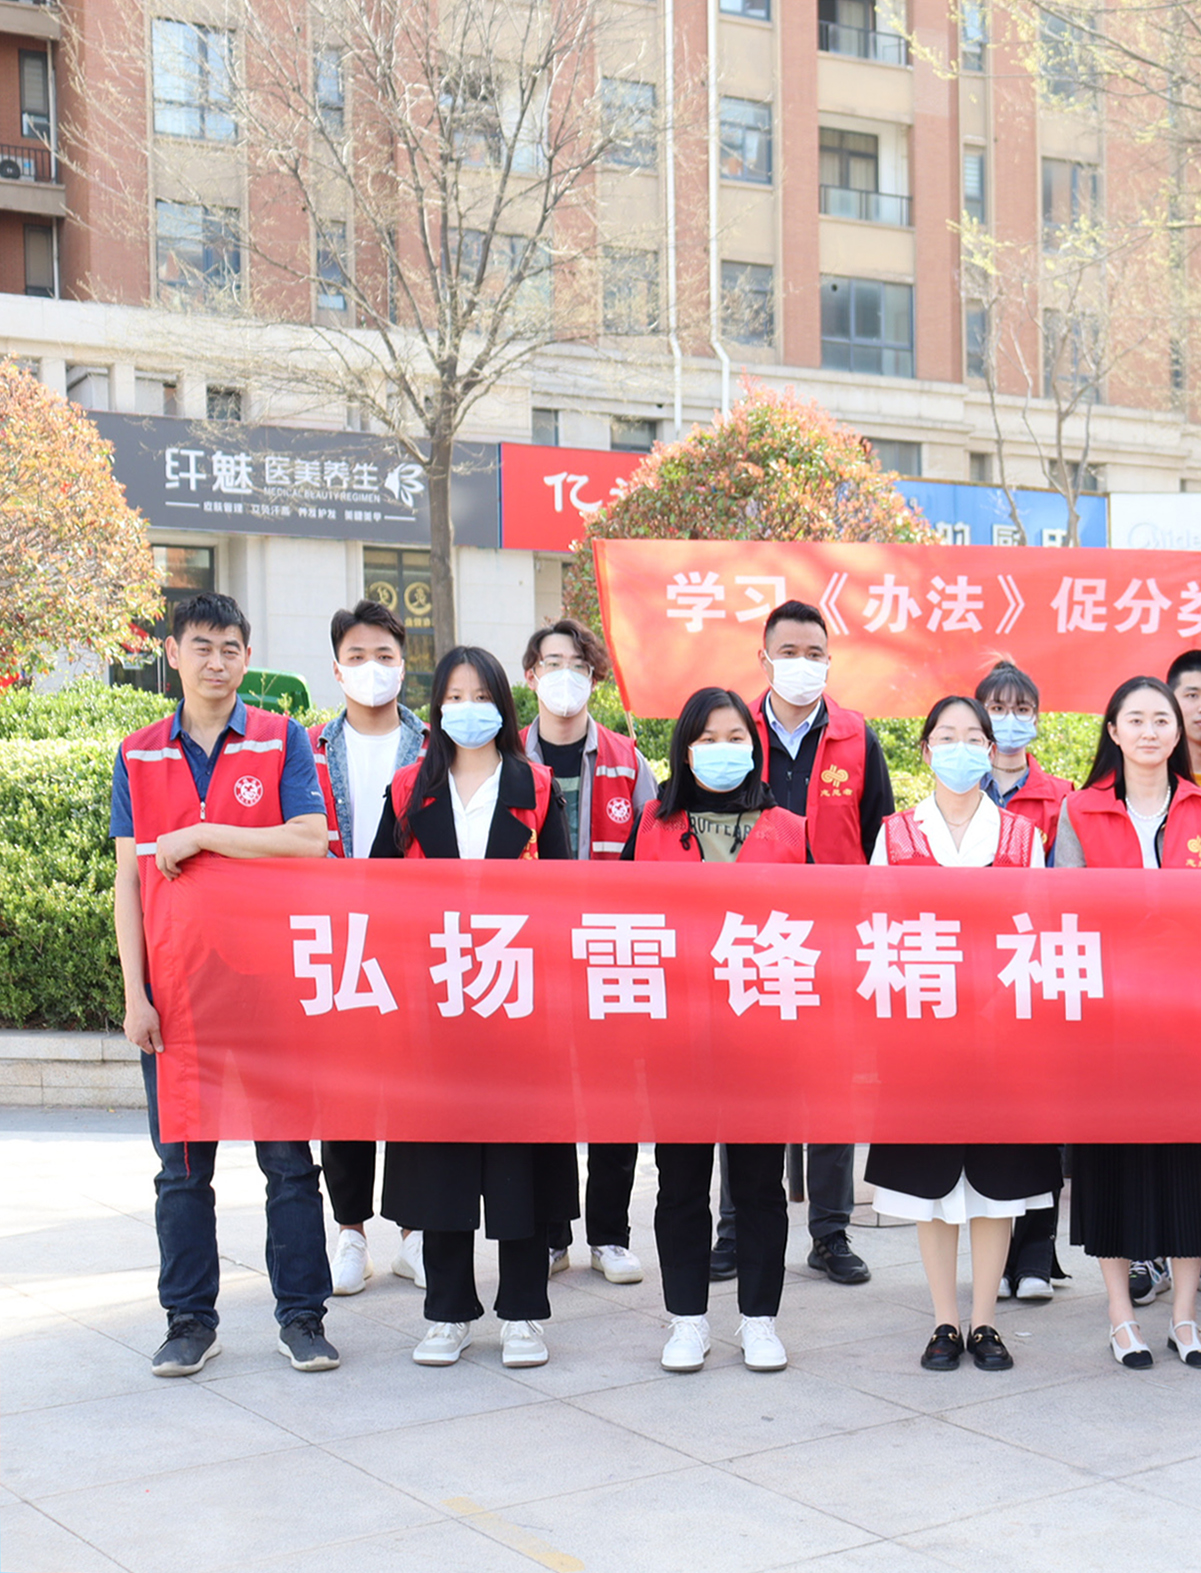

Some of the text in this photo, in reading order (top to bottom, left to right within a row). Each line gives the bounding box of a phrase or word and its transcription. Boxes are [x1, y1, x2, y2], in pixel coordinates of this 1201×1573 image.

[264, 454, 379, 491] 医美养生
[264, 486, 381, 503] MEDICAL BEAUTY REGIMEN
[289, 910, 1104, 1021] 弘扬雷锋精神
